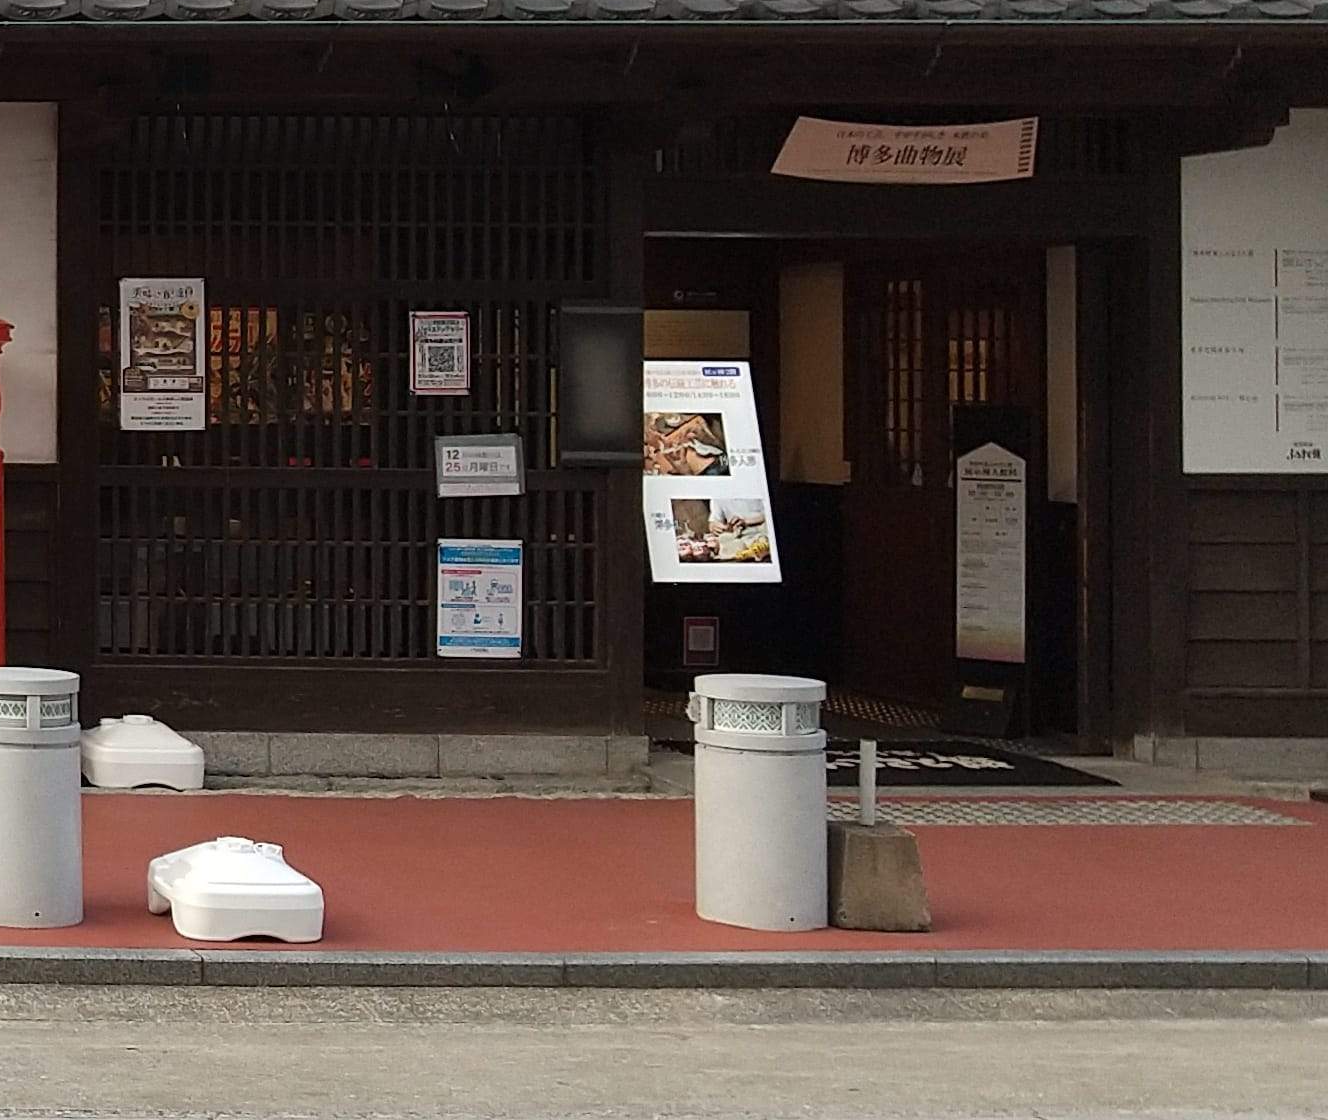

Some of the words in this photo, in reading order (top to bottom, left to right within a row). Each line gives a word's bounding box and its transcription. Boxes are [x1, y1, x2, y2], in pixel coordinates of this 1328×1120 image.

[845, 144, 969, 167] 博多曲物展
